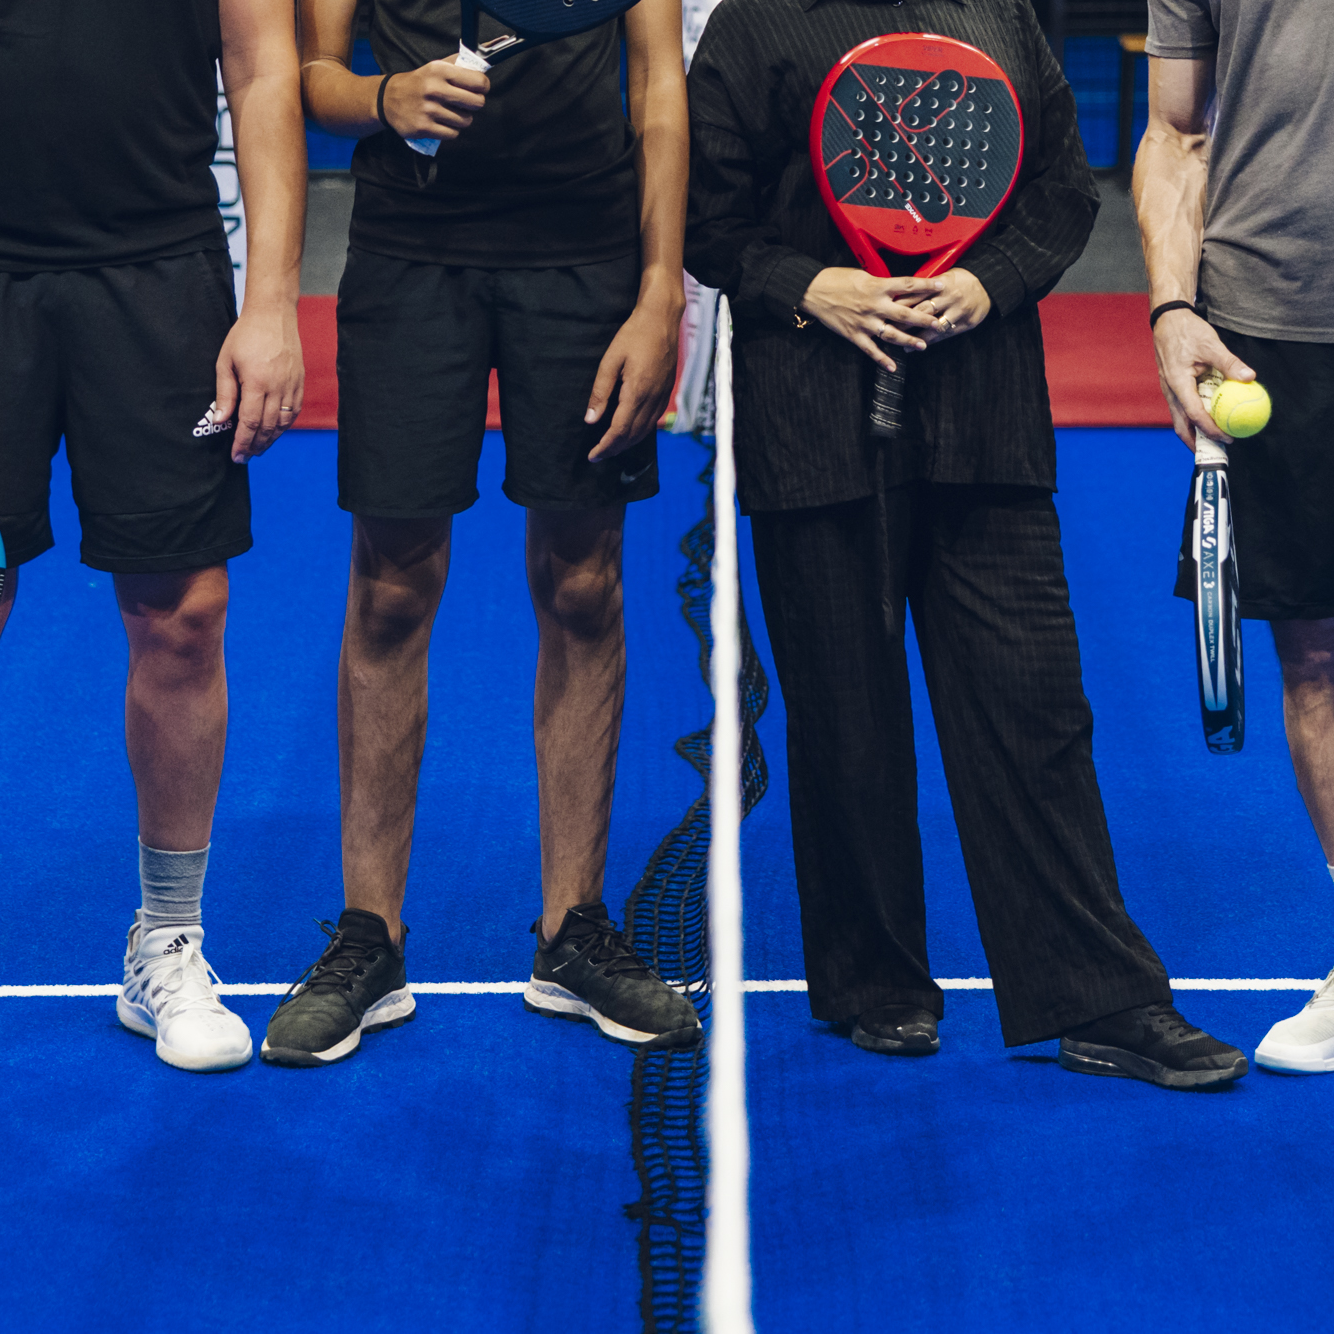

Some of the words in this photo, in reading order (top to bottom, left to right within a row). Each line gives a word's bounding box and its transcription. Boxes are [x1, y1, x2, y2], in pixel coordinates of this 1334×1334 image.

[192, 419, 233, 437] adidas
[1203, 502, 1215, 534] STIGA
[1203, 550, 1214, 579] AXE
[1207, 619, 1215, 644] DUPLEX
